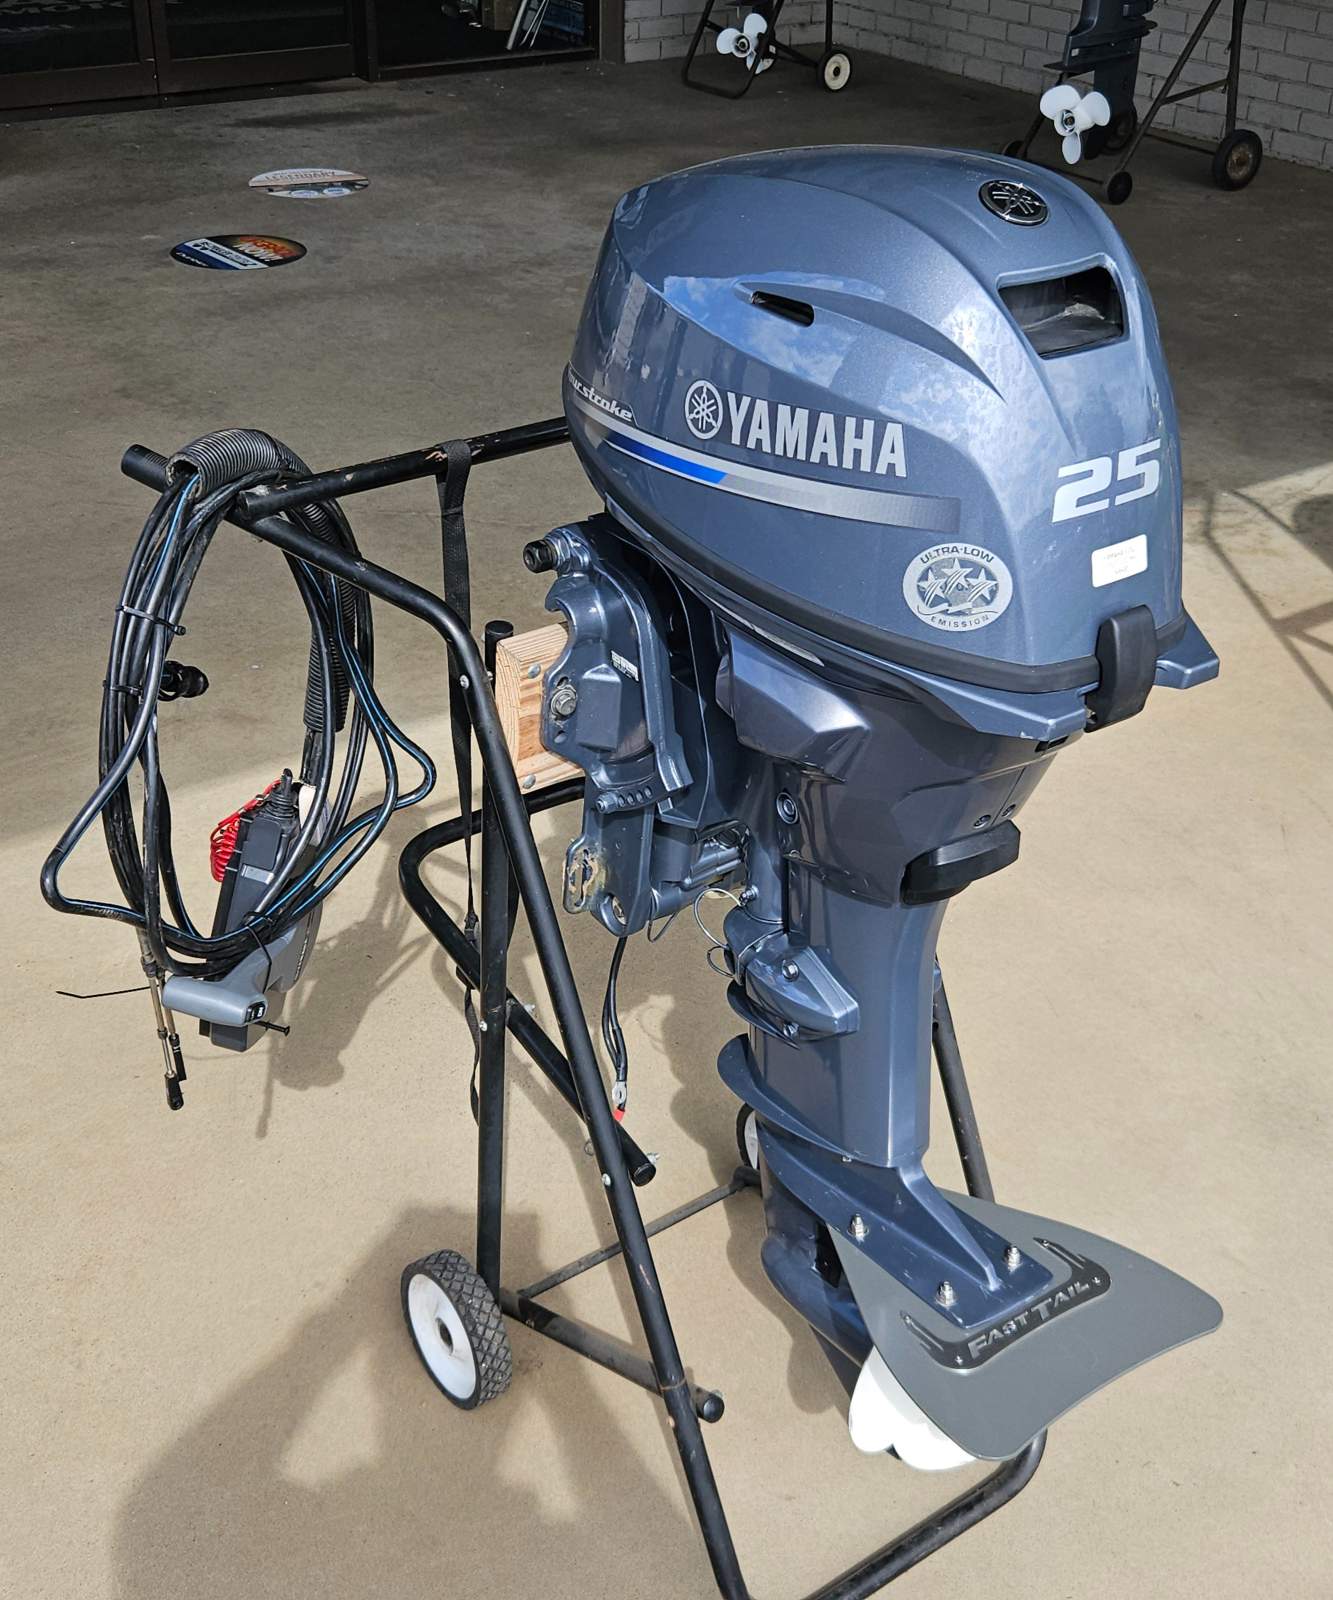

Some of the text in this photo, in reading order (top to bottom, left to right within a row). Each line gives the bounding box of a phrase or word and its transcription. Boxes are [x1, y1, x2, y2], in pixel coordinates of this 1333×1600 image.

[727, 391, 907, 478] YAMAHA
[1052, 439, 1161, 523] 25
[920, 545, 995, 564] ULTRA-LOW
[930, 615, 990, 629] EMISSION
[967, 1281, 1090, 1360] FAT TAIL
